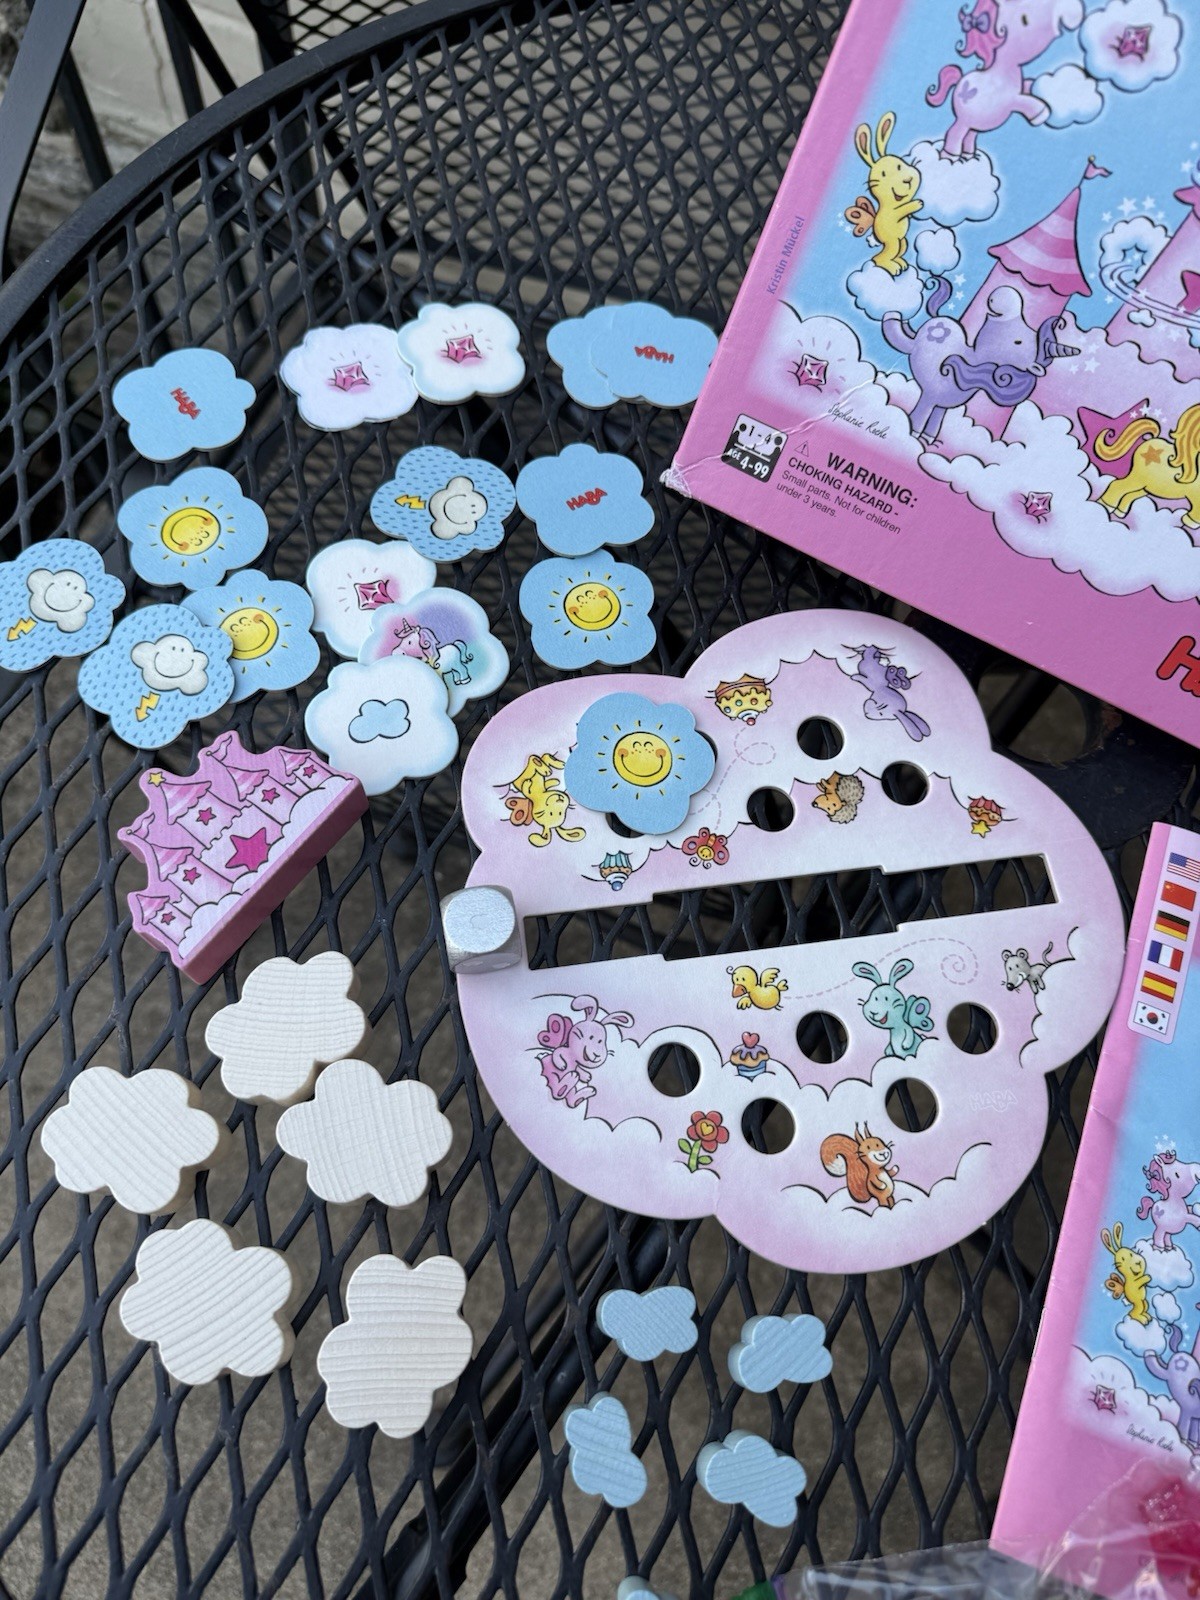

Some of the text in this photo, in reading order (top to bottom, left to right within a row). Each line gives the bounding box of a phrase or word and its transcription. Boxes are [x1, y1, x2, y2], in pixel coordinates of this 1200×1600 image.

[766, 215, 805, 295] Kristin Mückel
[634, 345, 675, 364] HABA
[170, 387, 202, 420] HABA
[740, 456, 770, 479] 4-99
[788, 456, 843, 491] CHOKING
[843, 484, 893, 515] HAZARD
[827, 452, 918, 508] WARNING:
[566, 487, 608, 511] HABA
[776, 482, 837, 518] under 3 years.
[782, 470, 901, 535] Small parts. Not for children
